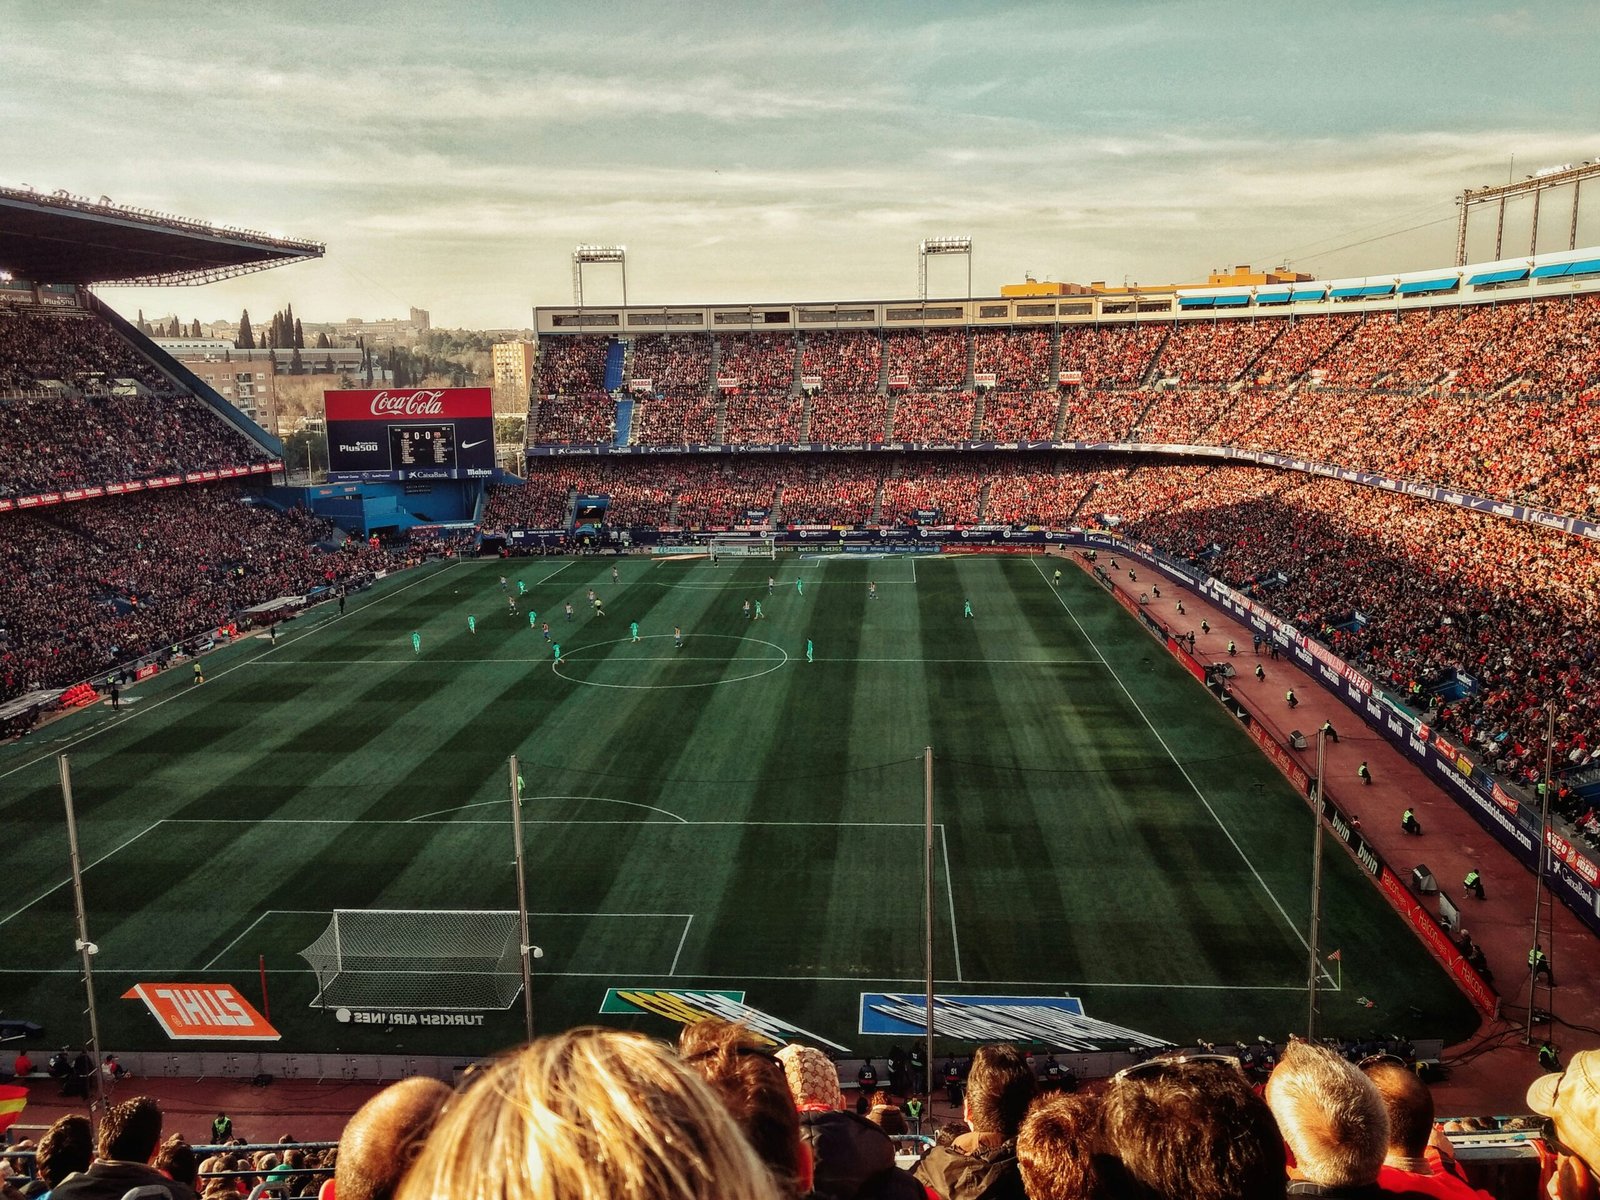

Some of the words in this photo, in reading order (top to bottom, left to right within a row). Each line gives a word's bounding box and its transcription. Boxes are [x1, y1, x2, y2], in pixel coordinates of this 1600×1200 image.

[370, 391, 445, 415] Coca-Cola
[339, 444, 378, 452] Plus500
[414, 431, 420, 440] 0
[425, 431, 431, 440] 0
[417, 471, 449, 479] CaixaBank
[1436, 758, 1532, 851] www.atleticodemadridstore.com
[1332, 811, 1350, 842] bwin
[1358, 841, 1378, 875] bwin
[155, 989, 254, 1026] STIHL
